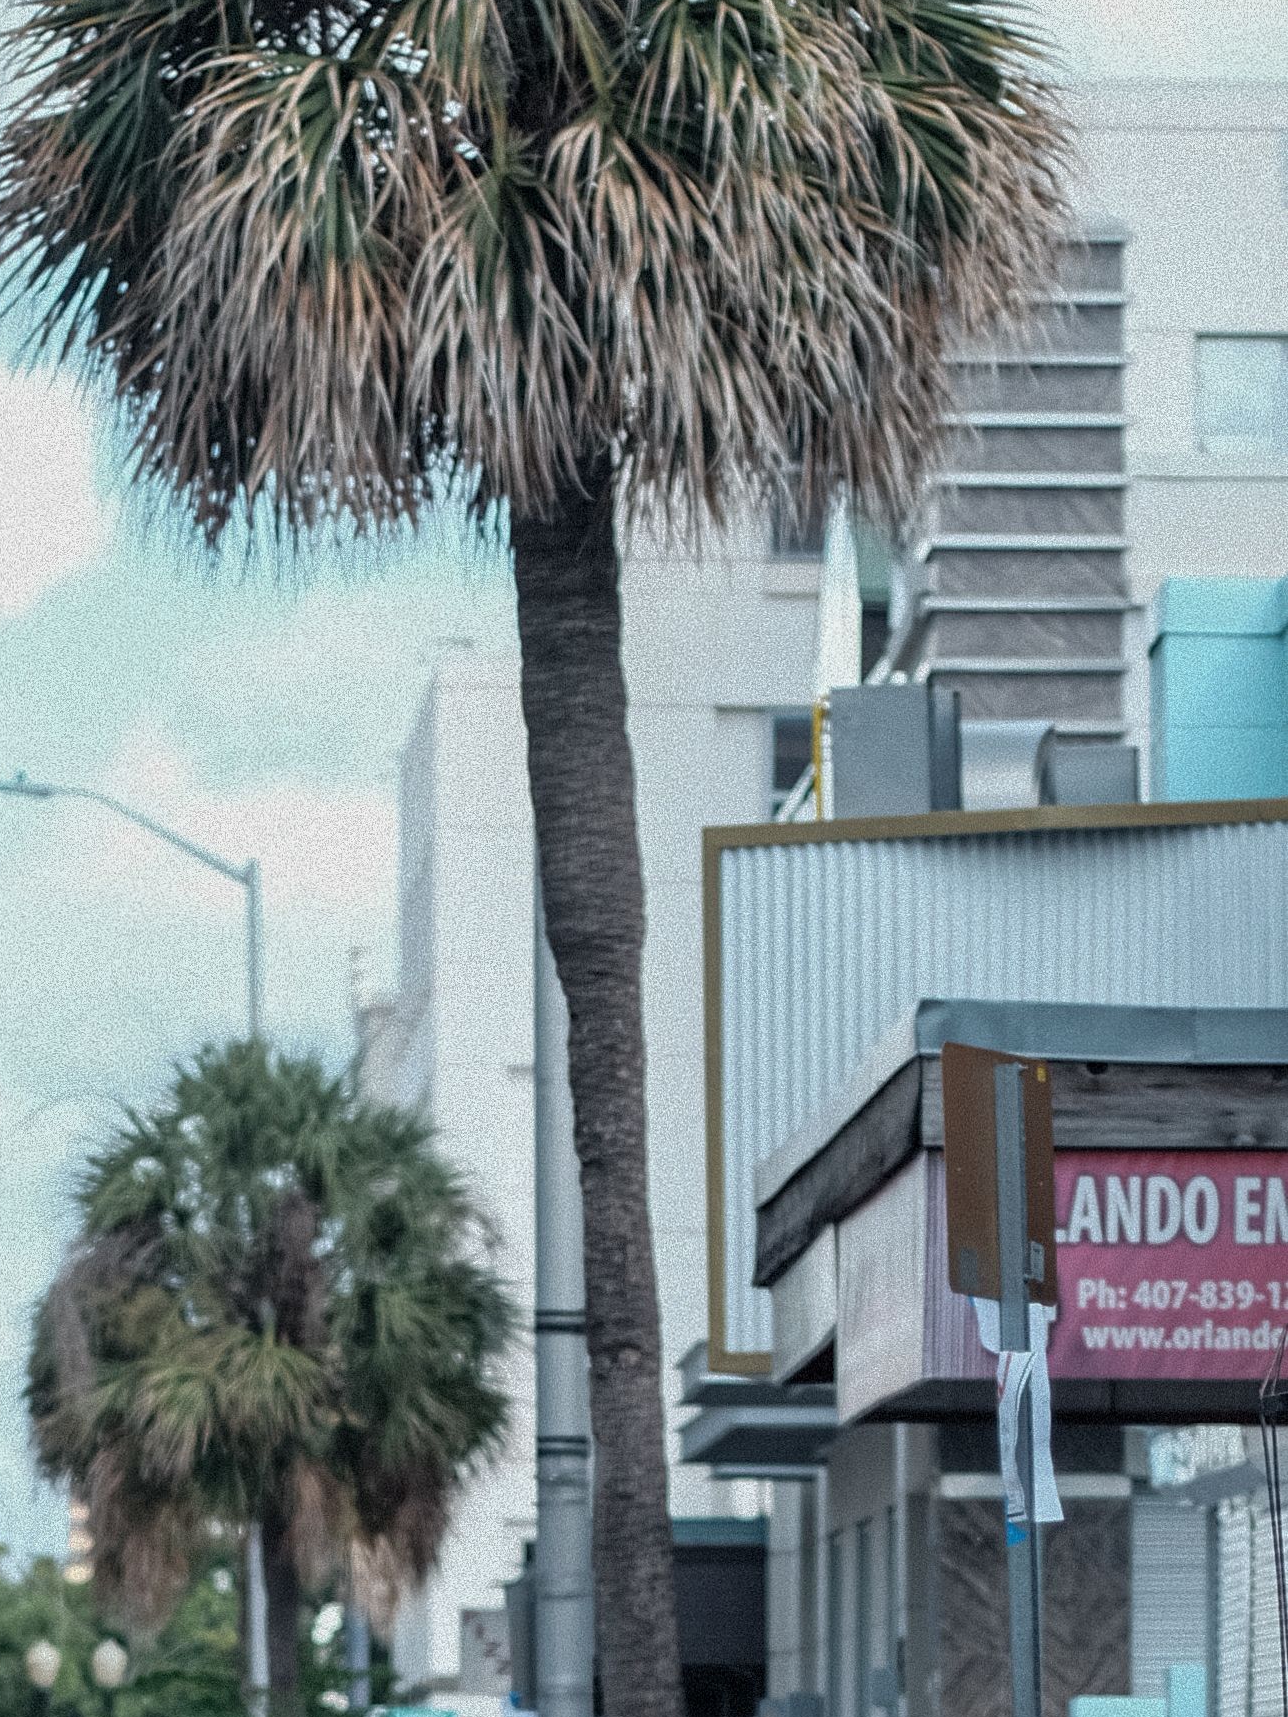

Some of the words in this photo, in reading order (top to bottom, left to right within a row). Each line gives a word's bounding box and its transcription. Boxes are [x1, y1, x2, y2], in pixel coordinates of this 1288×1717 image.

[1056, 1175, 1220, 1244] ANDO
[1078, 1278, 1127, 1309] Ph:
[1131, 1280, 1288, 1310] 407-839-1
